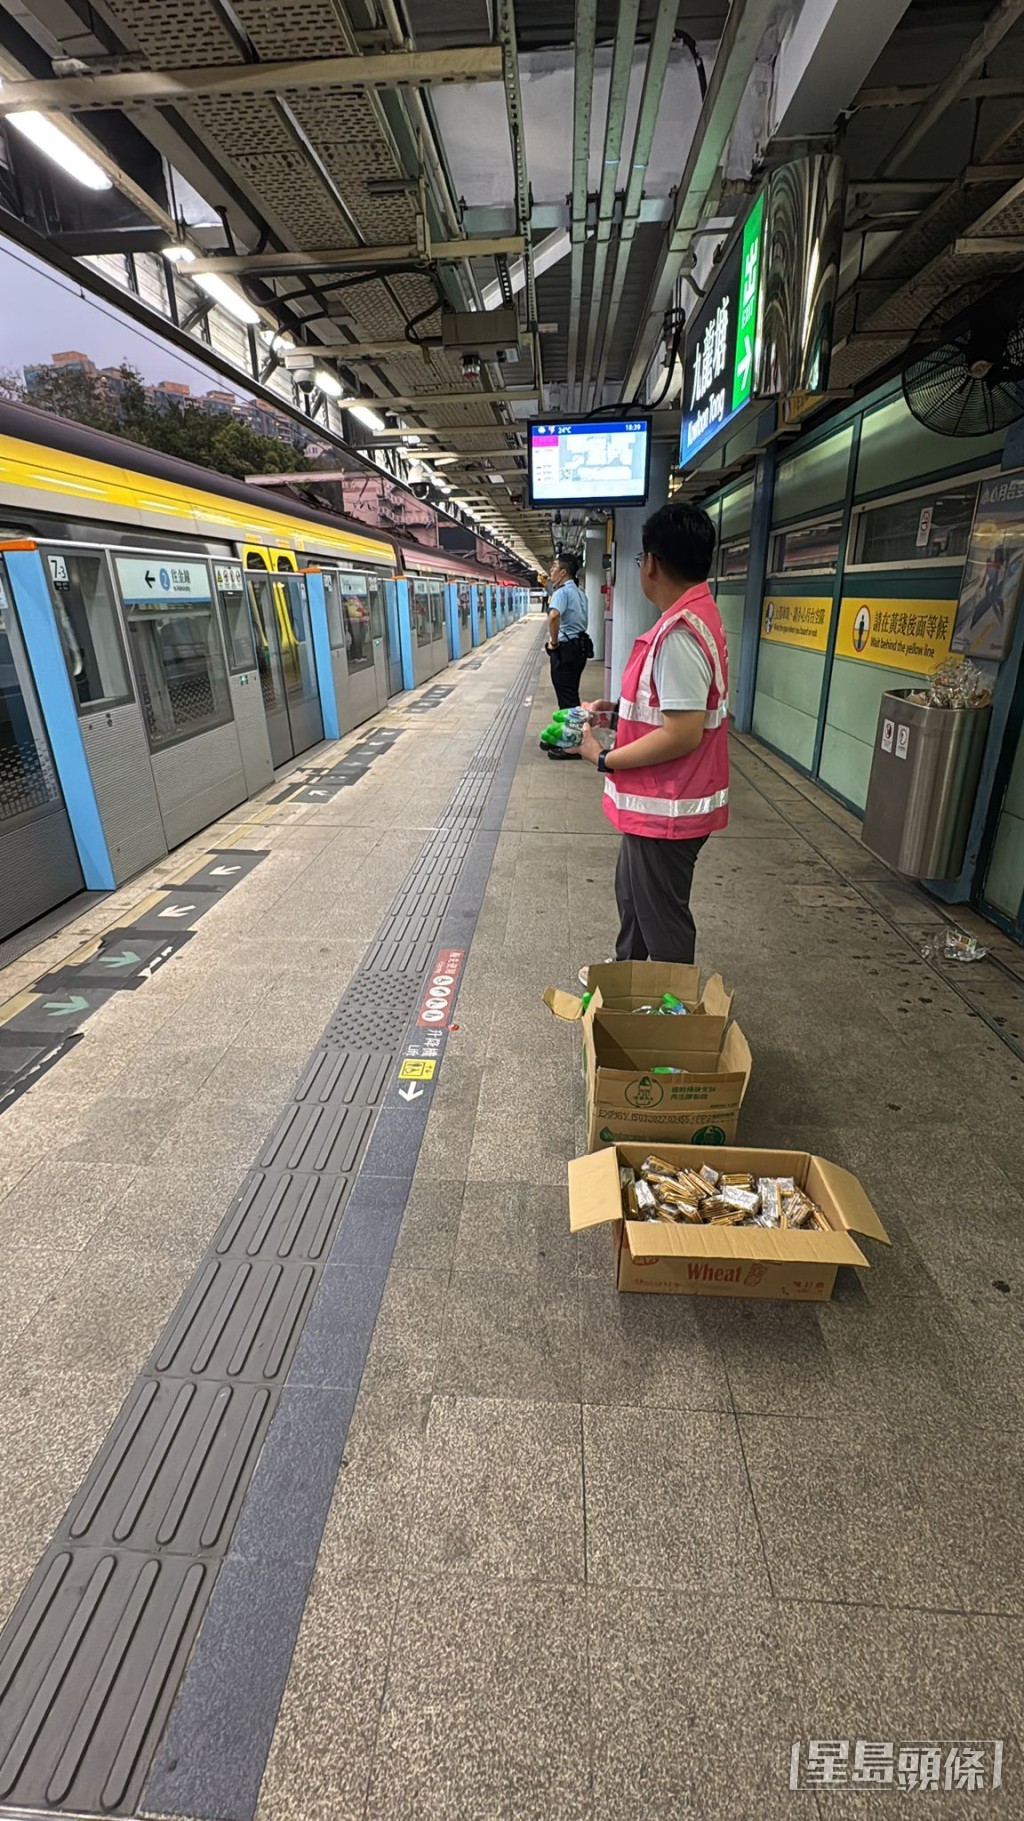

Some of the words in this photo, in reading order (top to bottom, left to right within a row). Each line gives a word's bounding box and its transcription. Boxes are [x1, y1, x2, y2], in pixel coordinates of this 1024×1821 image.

[743, 237, 758, 308] 出
[741, 297, 754, 330] EXIT
[690, 295, 730, 412] 九龍塘
[625, 423, 641, 431] 18:39
[687, 407, 709, 448] Kowloon
[709, 387, 726, 424] Tong
[870, 636, 881, 647] Wait
[881, 638, 897, 650] behind
[897, 640, 905, 652] the
[905, 642, 923, 656] yellow
[924, 644, 935, 658] line
[687, 1262, 741, 1283] Wheat
